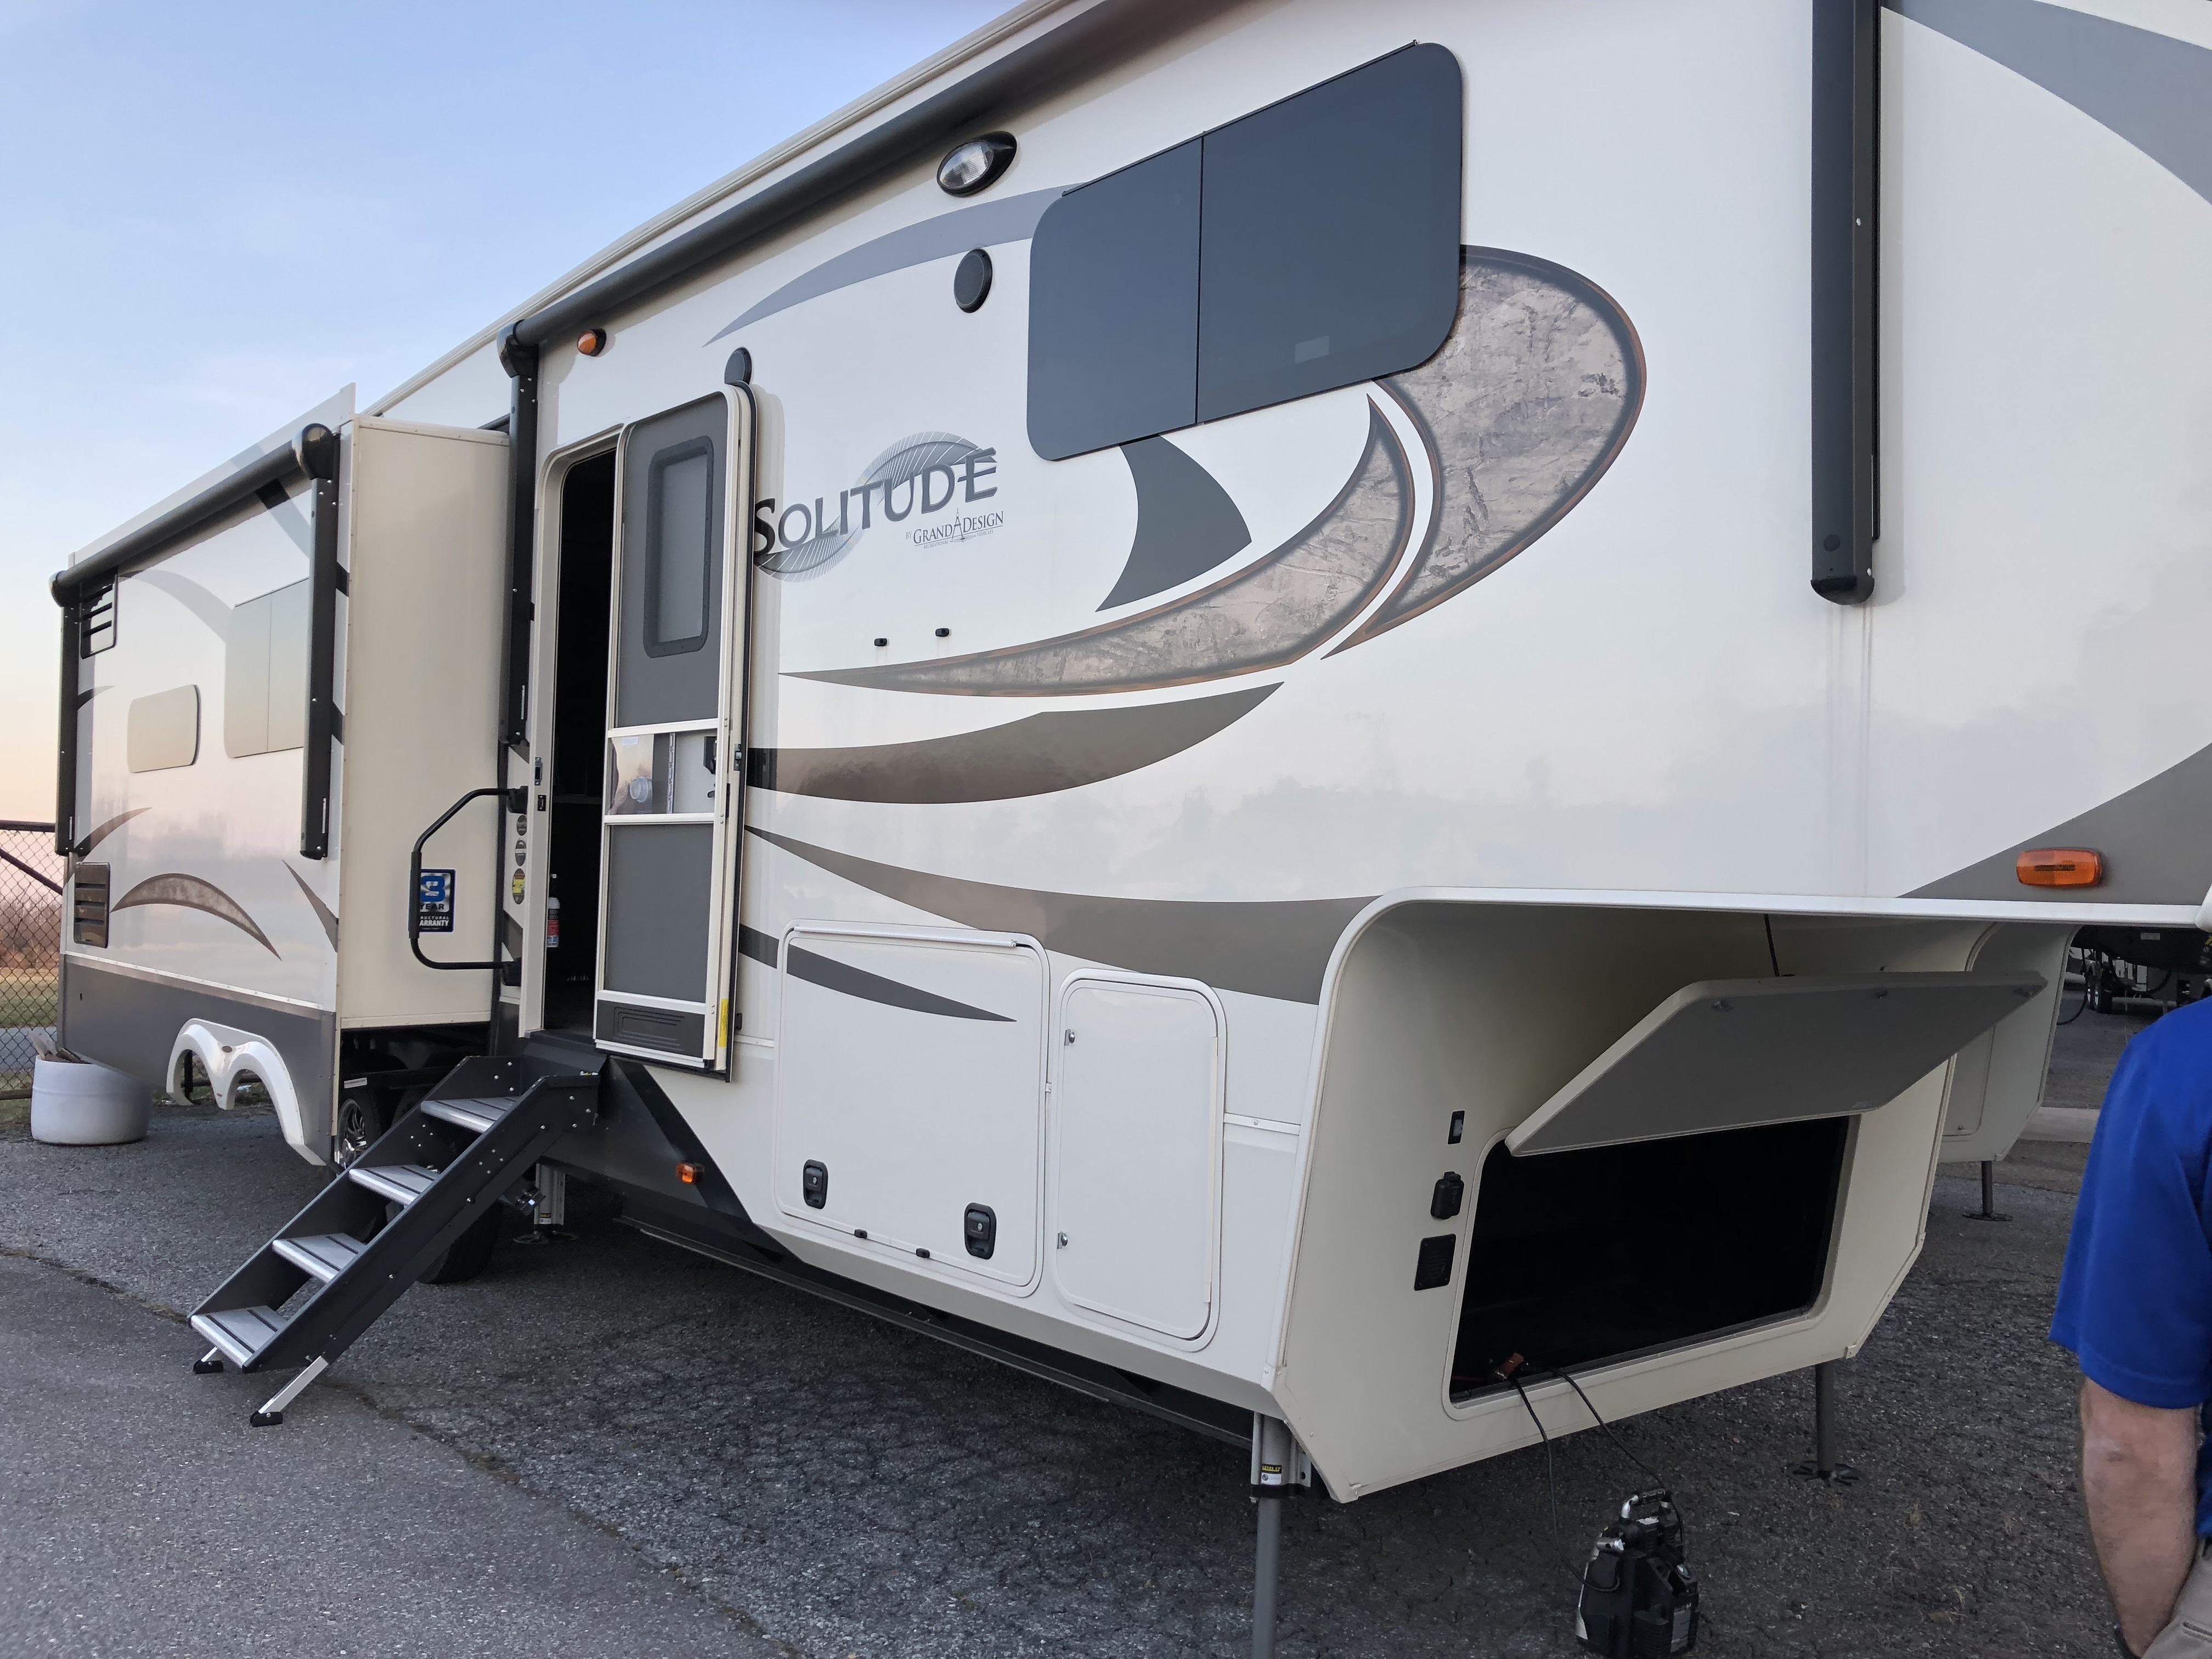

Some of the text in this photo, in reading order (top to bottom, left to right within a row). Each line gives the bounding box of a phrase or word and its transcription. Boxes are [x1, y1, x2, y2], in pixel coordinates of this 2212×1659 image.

[754, 447, 997, 557] SOLITUDE
[906, 511, 1004, 544] BY GRAND DESIGN
[923, 540, 949, 549] RECREATIONAL
[420, 876, 445, 902] 3
